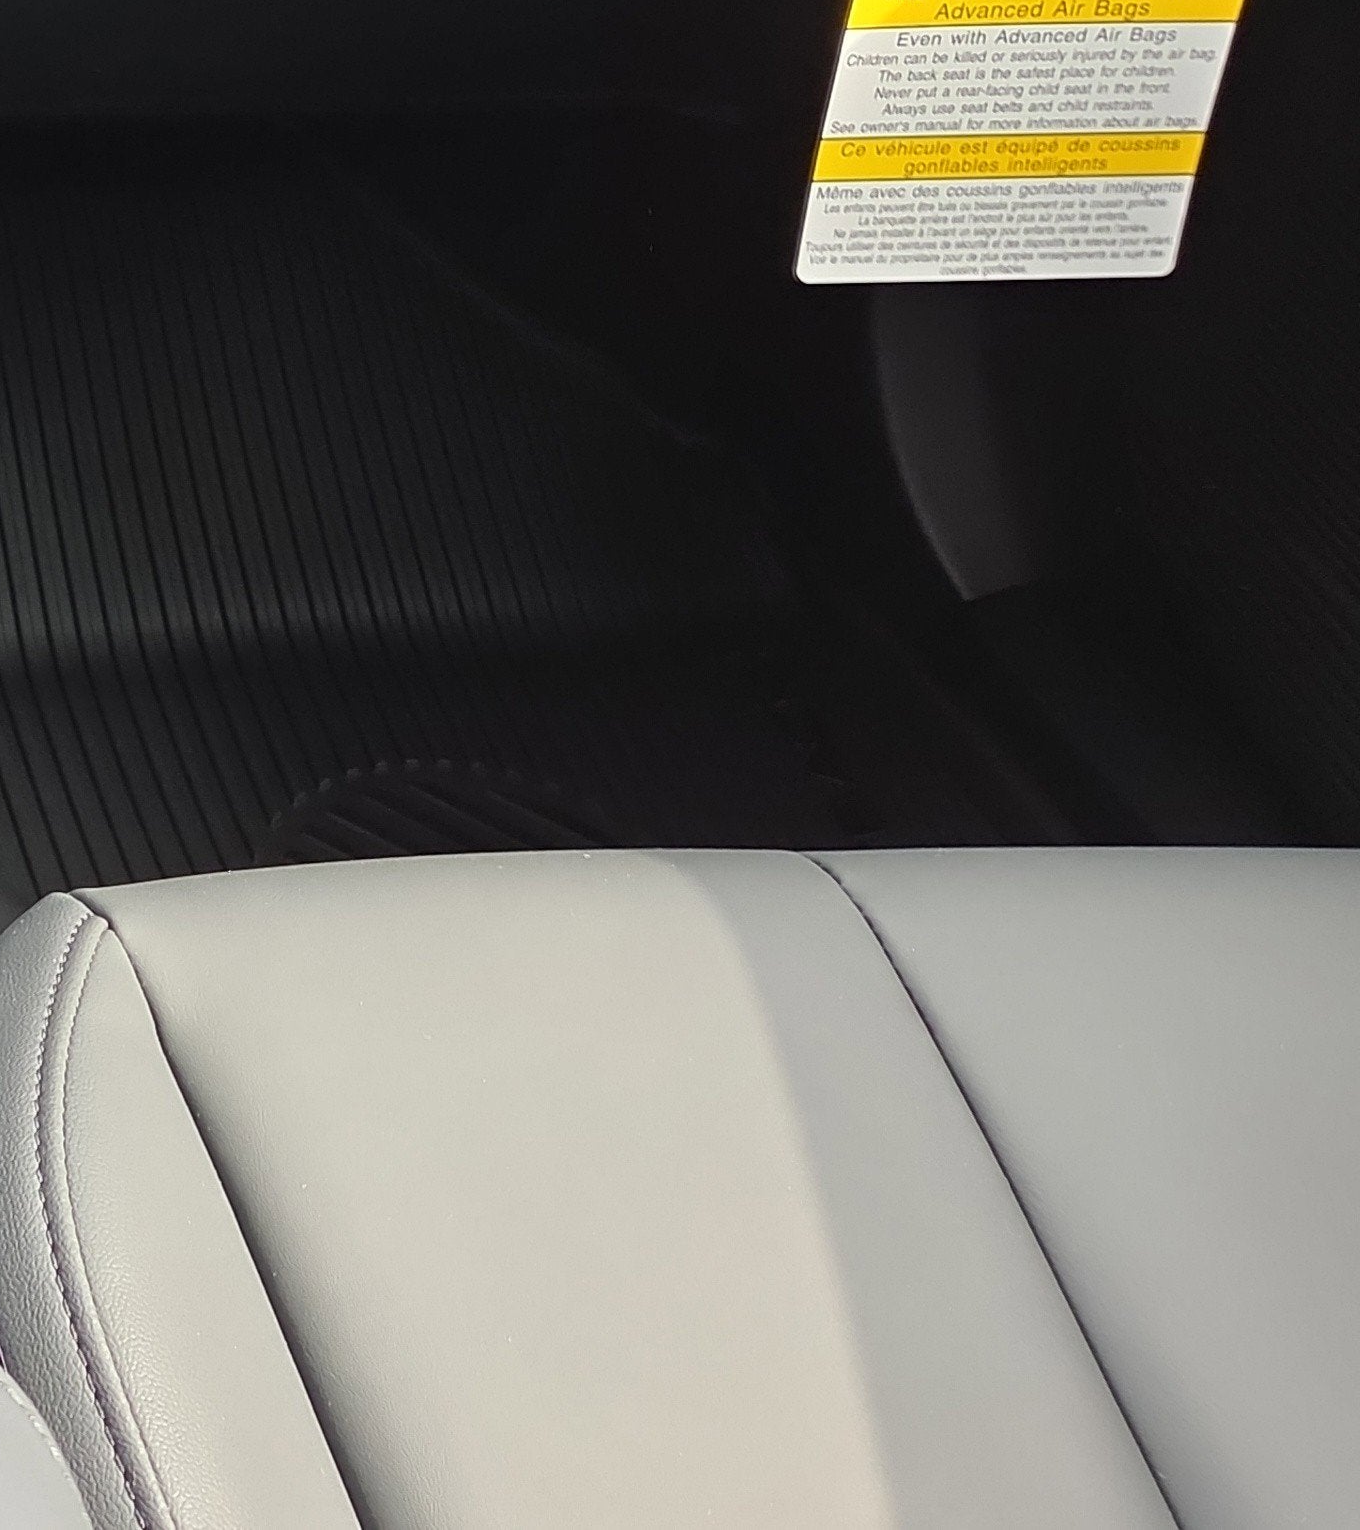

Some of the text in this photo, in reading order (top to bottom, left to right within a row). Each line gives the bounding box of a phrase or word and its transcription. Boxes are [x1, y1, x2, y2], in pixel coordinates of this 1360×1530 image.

[934, 1, 1044, 20] Advanced
[1053, 0, 1086, 18] Air
[896, 26, 1178, 47] Even with Advanced Air Bags
[846, 53, 898, 67] Children
[903, 54, 926, 65] can
[932, 52, 948, 64] be
[954, 50, 988, 64] killed
[991, 52, 1006, 62] or
[1010, 49, 1068, 64] seriously
[1072, 48, 1116, 62] injured
[1120, 48, 1138, 62] by
[1142, 48, 1163, 60] the
[1168, 48, 1186, 60] air
[879, 70, 902, 83] The
[907, 68, 937, 82] back
[942, 68, 971, 81] seat
[974, 67, 986, 80] is
[990, 67, 1012, 80] the
[1016, 66, 1056, 79] safest
[1059, 66, 1096, 80] place
[874, 86, 912, 100] Never
[915, 86, 938, 100] put
[942, 87, 950, 98] a
[1028, 82, 1060, 96] child
[1063, 82, 1093, 96] seat
[1096, 82, 1110, 94] in
[1113, 82, 1135, 94] the
[881, 102, 927, 117] Always
[931, 104, 956, 114] use
[960, 102, 989, 114] seat
[992, 100, 1023, 114] belts
[1027, 100, 1054, 112] and
[1056, 100, 1090, 112] child
[830, 120, 856, 134] See
[914, 118, 962, 132] manual
[966, 118, 984, 130] for
[988, 118, 1022, 130] more
[840, 136, 1182, 158] Ce véhicule est équipé de coussins
[903, 157, 1108, 178] gonflables intelligents
[816, 186, 864, 200] Même
[870, 186, 906, 199] avec
[911, 184, 940, 198] des
[946, 184, 1012, 198] coussins
[1018, 181, 1096, 199] gonflables
